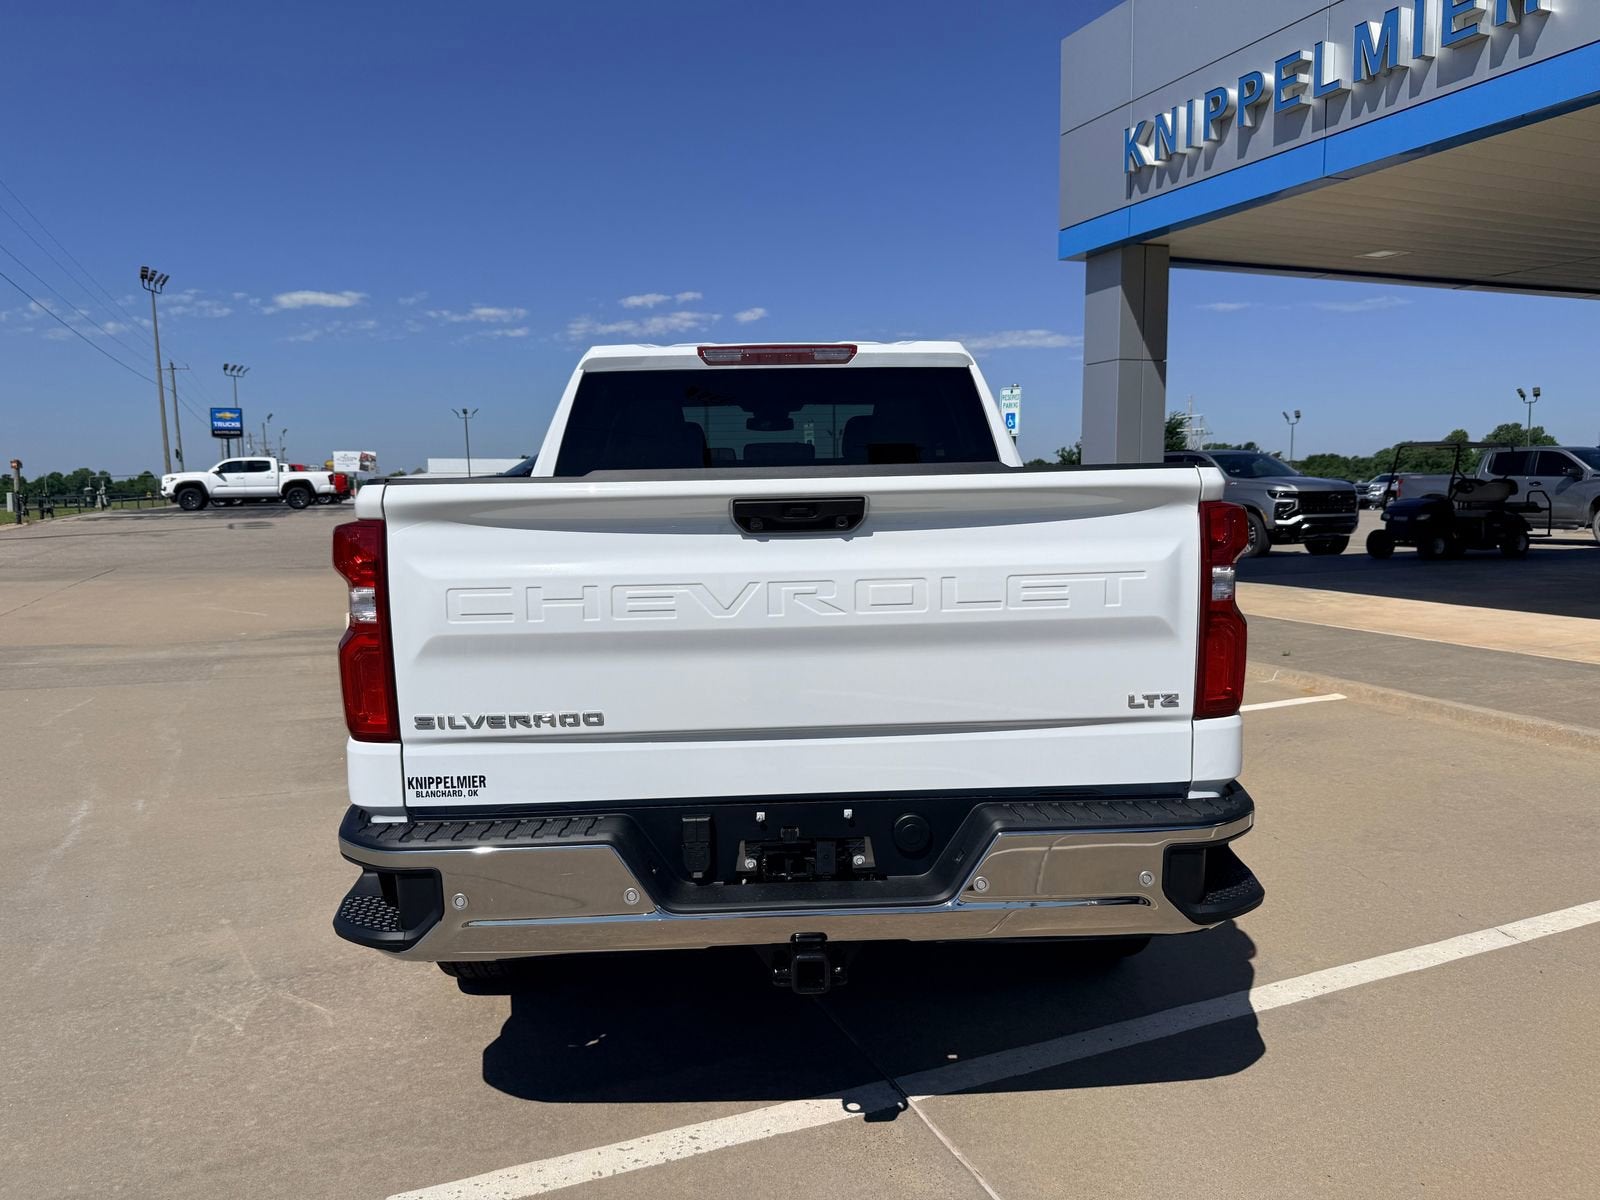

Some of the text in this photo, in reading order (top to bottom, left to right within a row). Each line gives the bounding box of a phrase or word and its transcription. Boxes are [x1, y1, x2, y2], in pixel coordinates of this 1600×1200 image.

[445, 570, 1147, 625] CHEVROLET
[1127, 693, 1180, 709] LTZ
[413, 710, 605, 731] SILVERADO
[407, 775, 487, 790] KNIPPELMIER
[415, 788, 479, 799] BLANCHARD, OK
